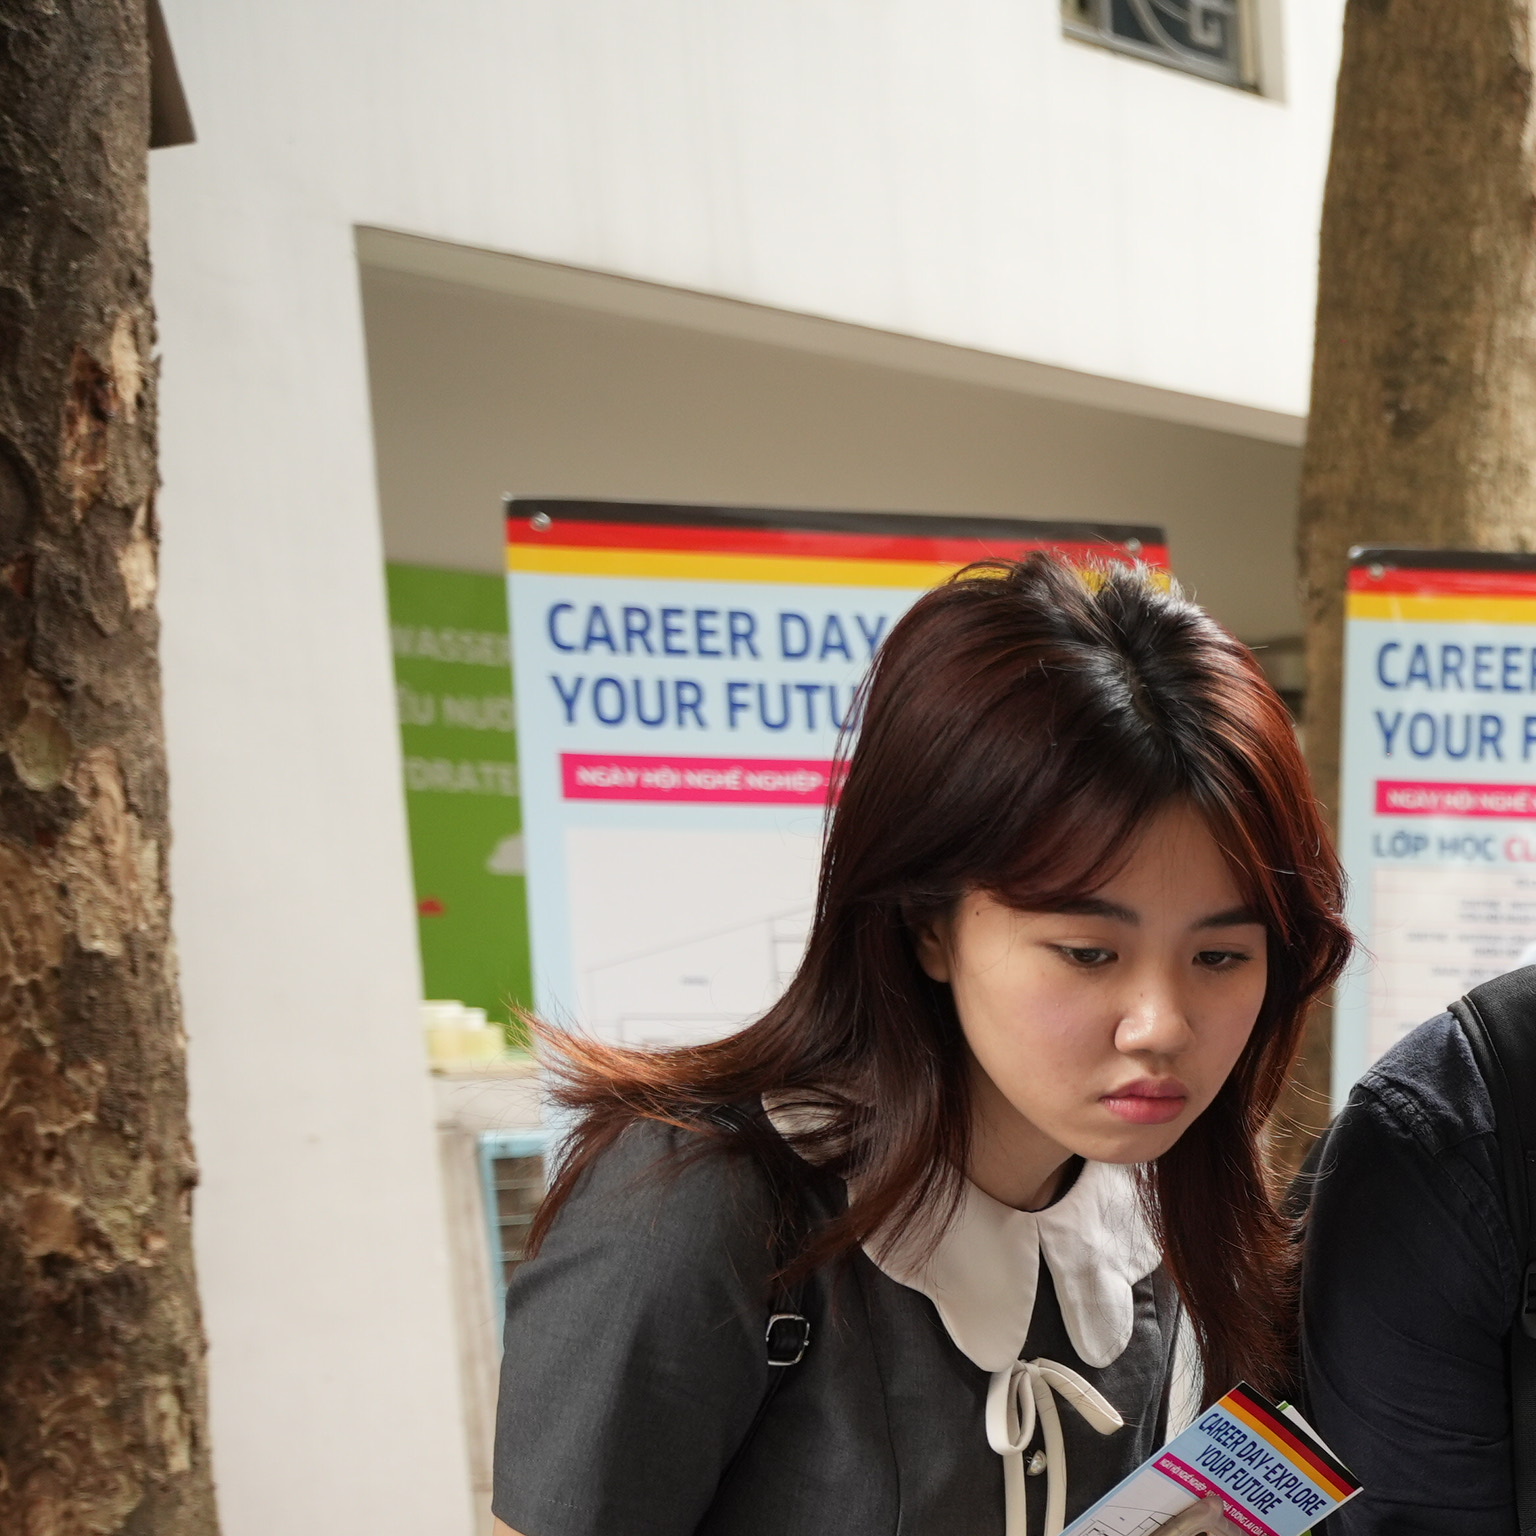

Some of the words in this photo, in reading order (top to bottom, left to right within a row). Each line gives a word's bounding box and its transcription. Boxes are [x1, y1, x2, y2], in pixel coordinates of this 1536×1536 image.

[548, 603, 757, 659] CAREER
[779, 612, 886, 662] DAY
[551, 675, 708, 730] YOUR
[1376, 710, 1505, 762] YOUR
[1198, 1413, 1248, 1452] CAREER
[1196, 1444, 1236, 1479] YOUR
[1224, 1468, 1283, 1516] FUTURE
